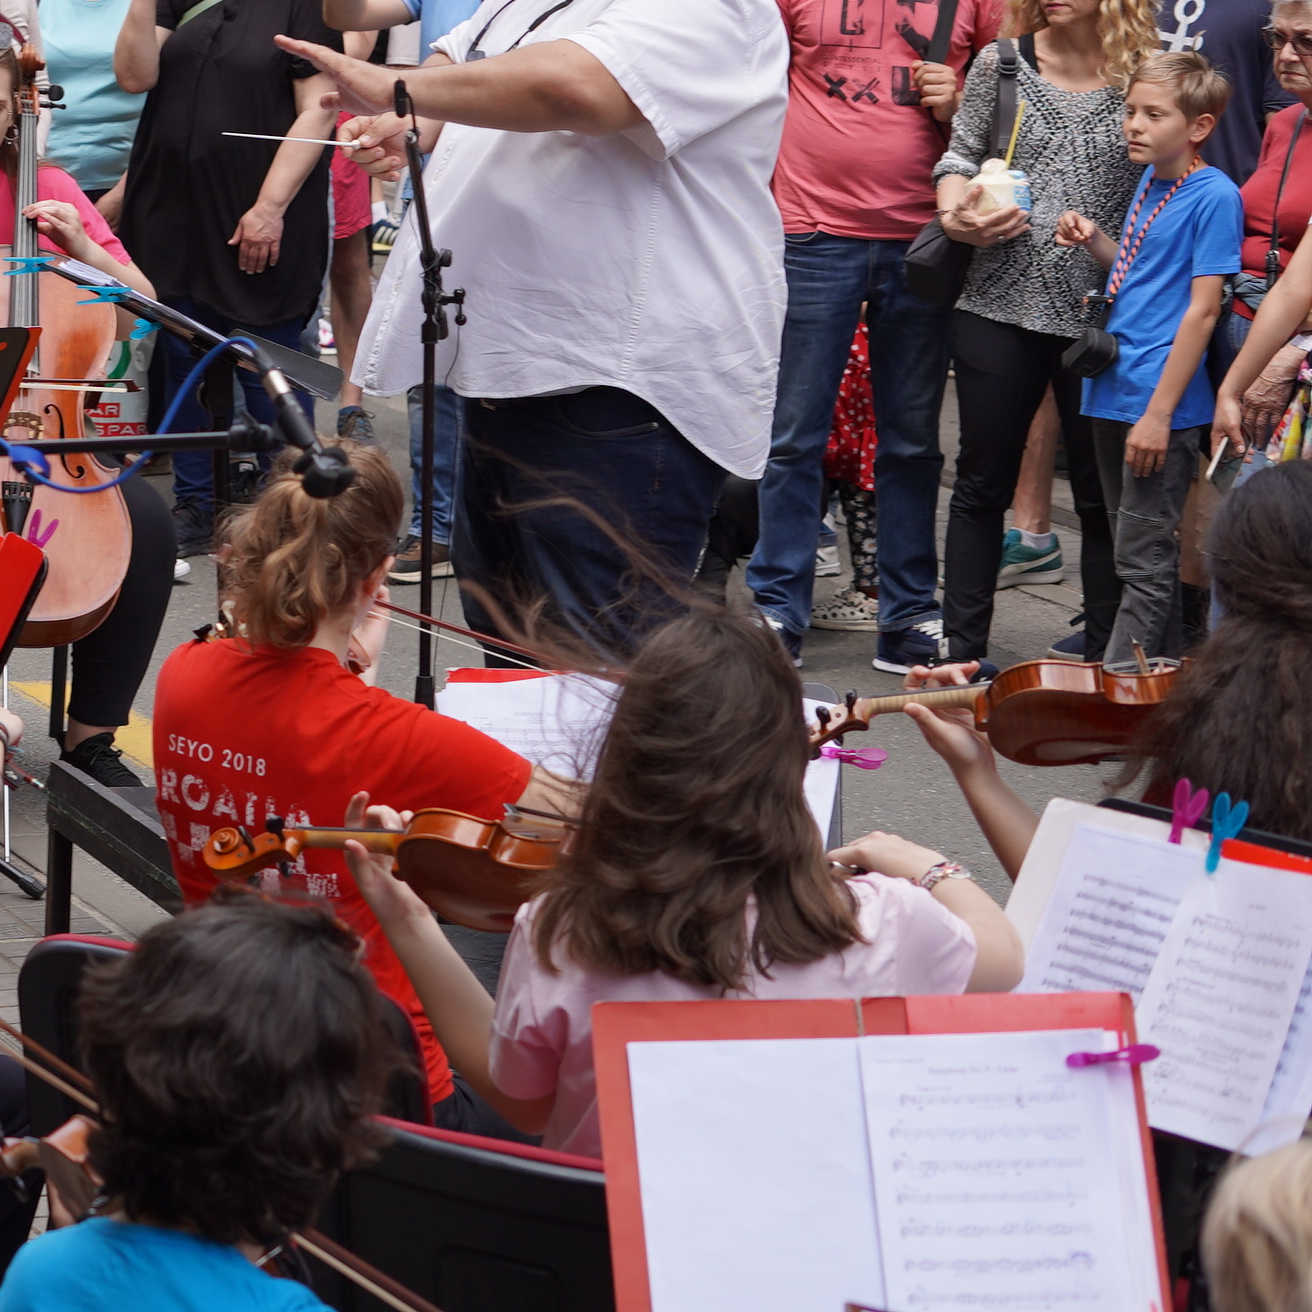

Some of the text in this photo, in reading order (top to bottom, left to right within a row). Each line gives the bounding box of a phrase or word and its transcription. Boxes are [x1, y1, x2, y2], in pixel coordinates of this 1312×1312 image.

[89, 405, 119, 417] AR
[168, 733, 266, 777] SEYO 2018
